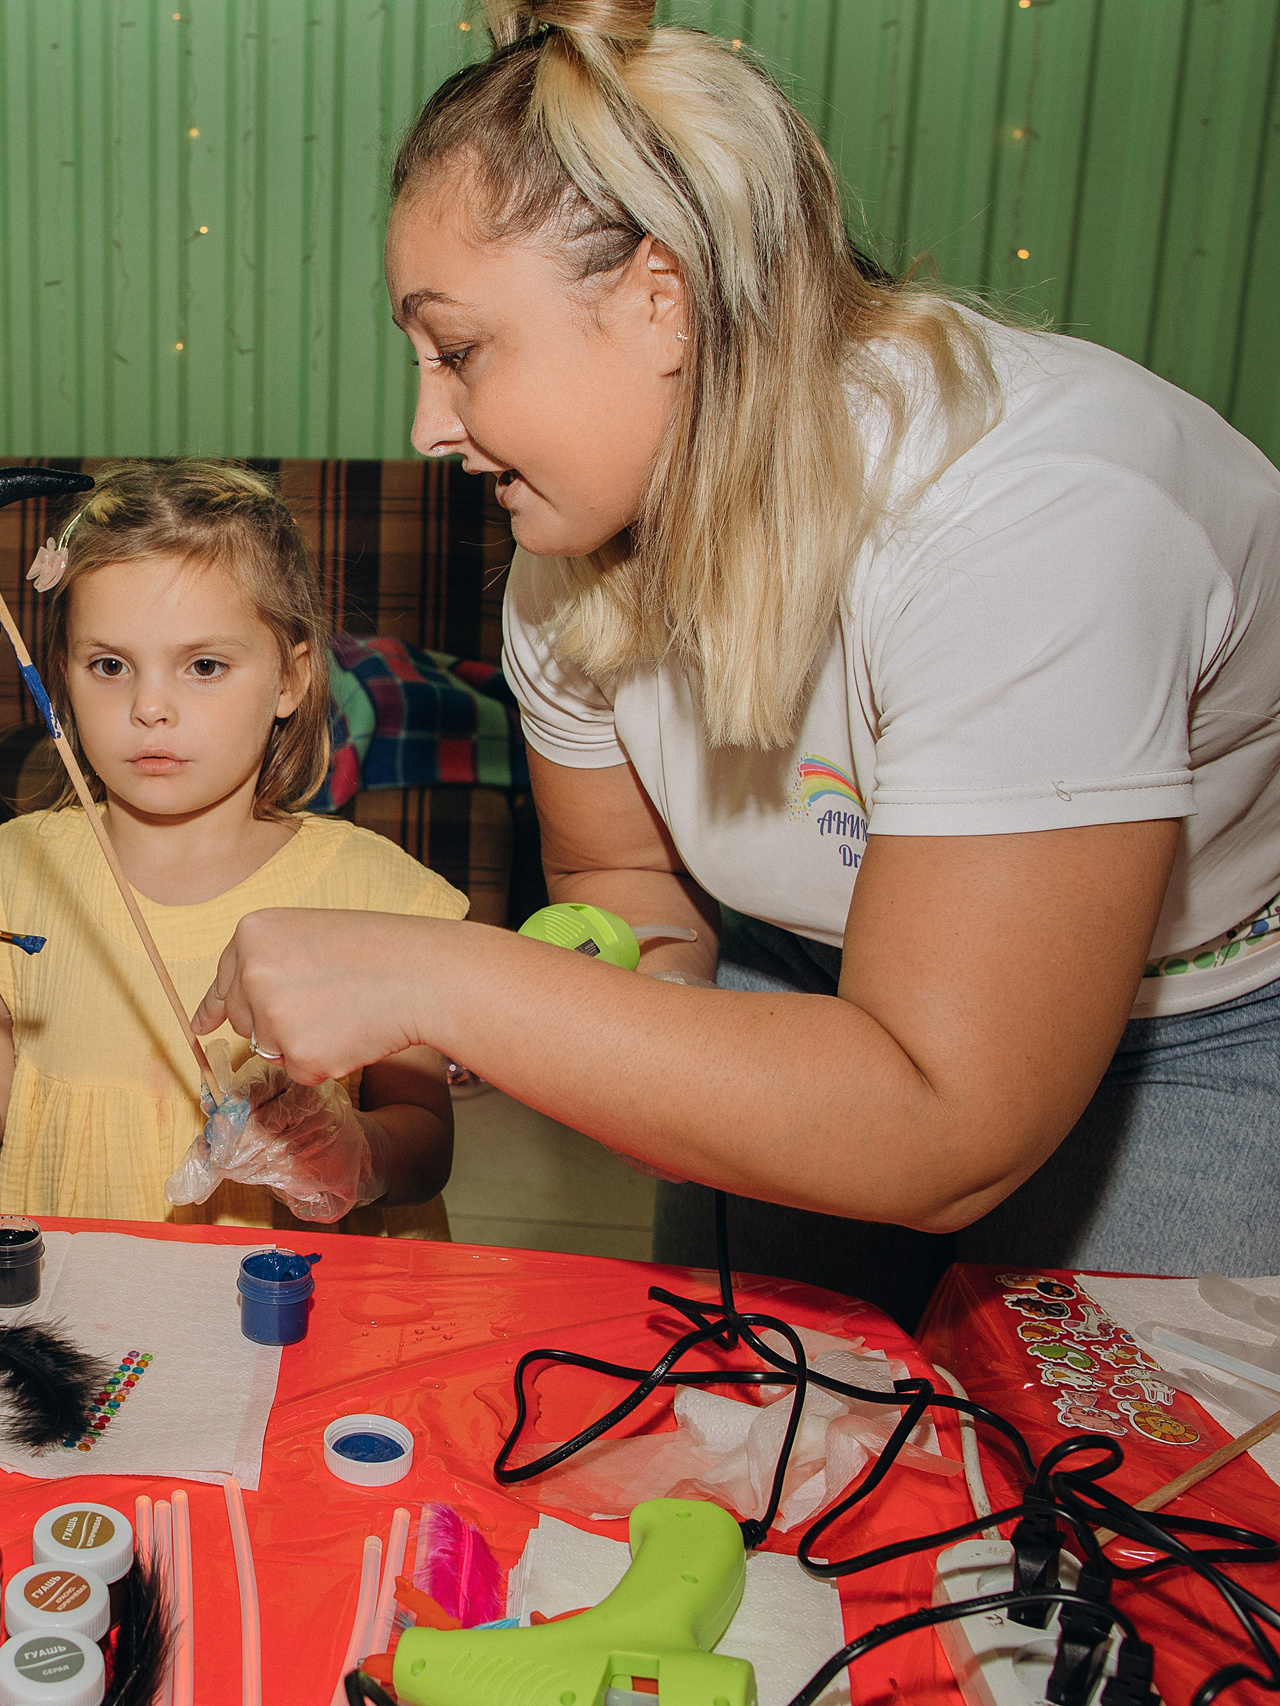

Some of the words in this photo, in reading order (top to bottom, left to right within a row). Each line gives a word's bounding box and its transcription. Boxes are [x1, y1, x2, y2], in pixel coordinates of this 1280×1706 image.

[61, 1516, 78, 1541] ГУАШЬ
[86, 1516, 103, 1547] КОРИЧНЕВАЯ
[31, 1574, 61, 1599] ГУАШЬ
[23, 1644, 67, 1661] ГУАШЬ
[42, 1664, 70, 1676] СЕРАЯ
